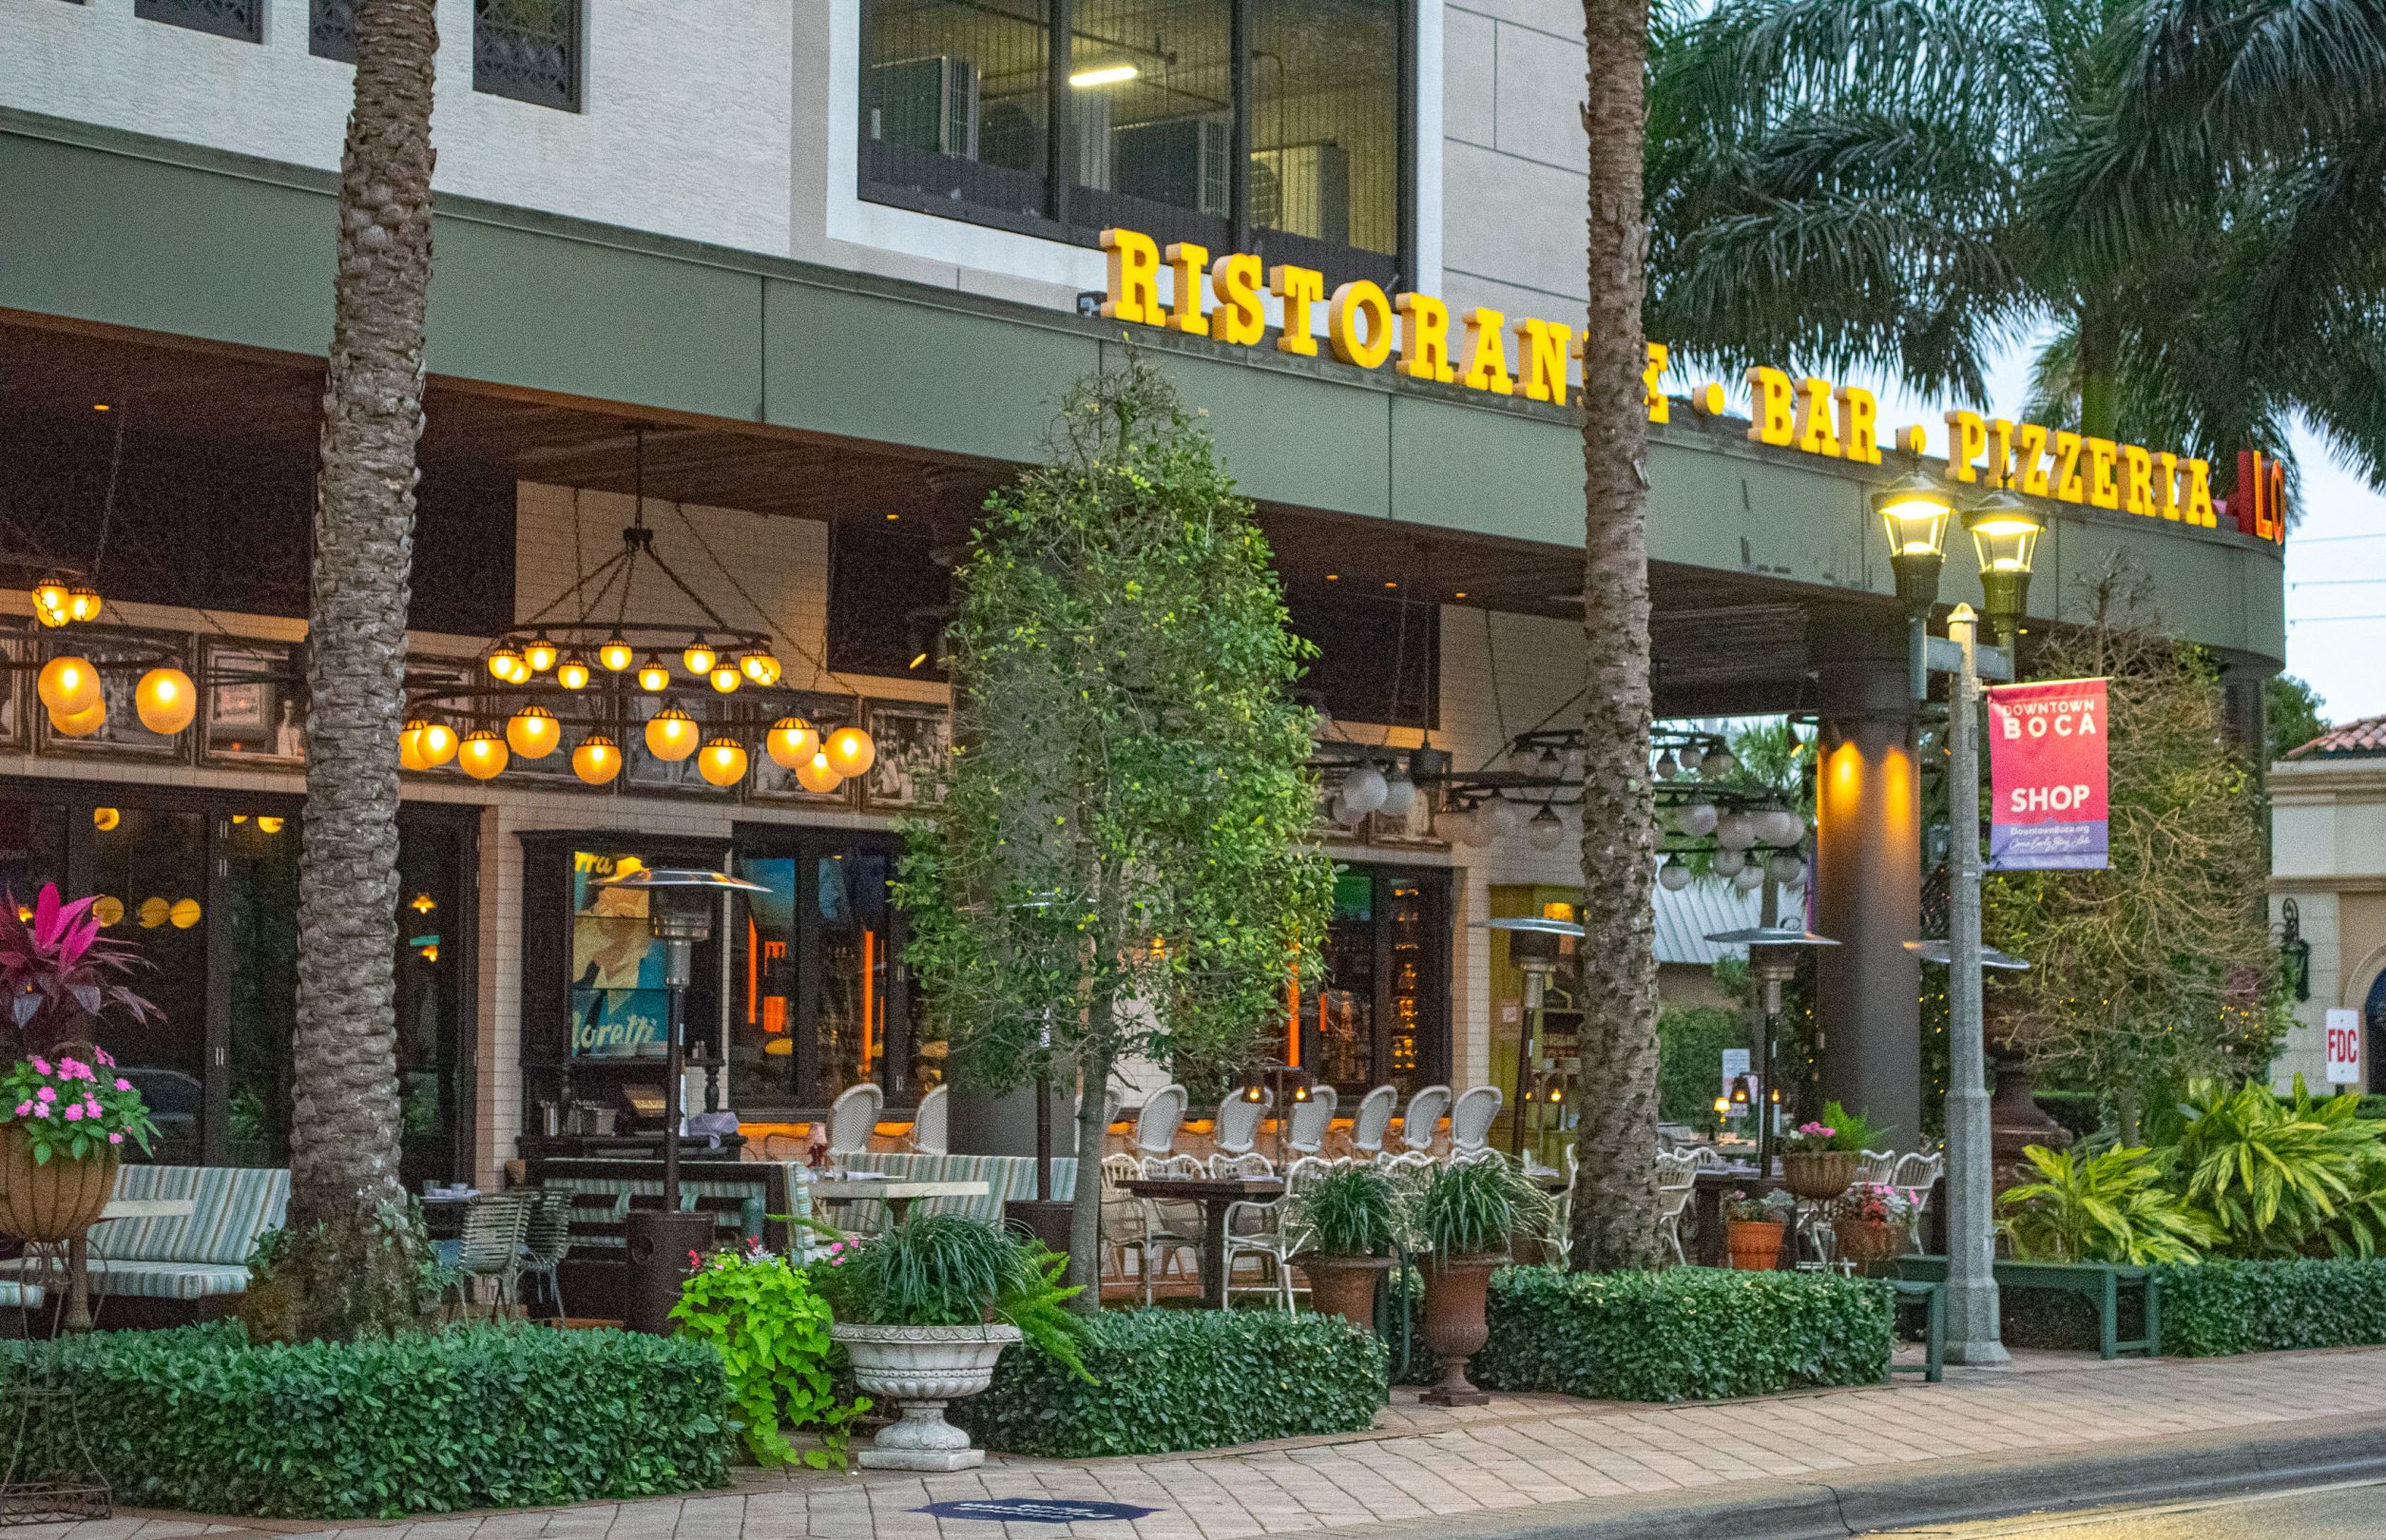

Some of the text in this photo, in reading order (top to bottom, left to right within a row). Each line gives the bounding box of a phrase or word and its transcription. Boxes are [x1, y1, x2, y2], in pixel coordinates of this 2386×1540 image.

[1101, 228, 2217, 529] RISTORANE BAR PIZZERIA
[2002, 700, 2094, 717] DOWNTOWN
[2003, 713, 2096, 740] BOCA
[2010, 784, 2090, 813] SHOP
[2328, 1030, 2357, 1063] FDC
